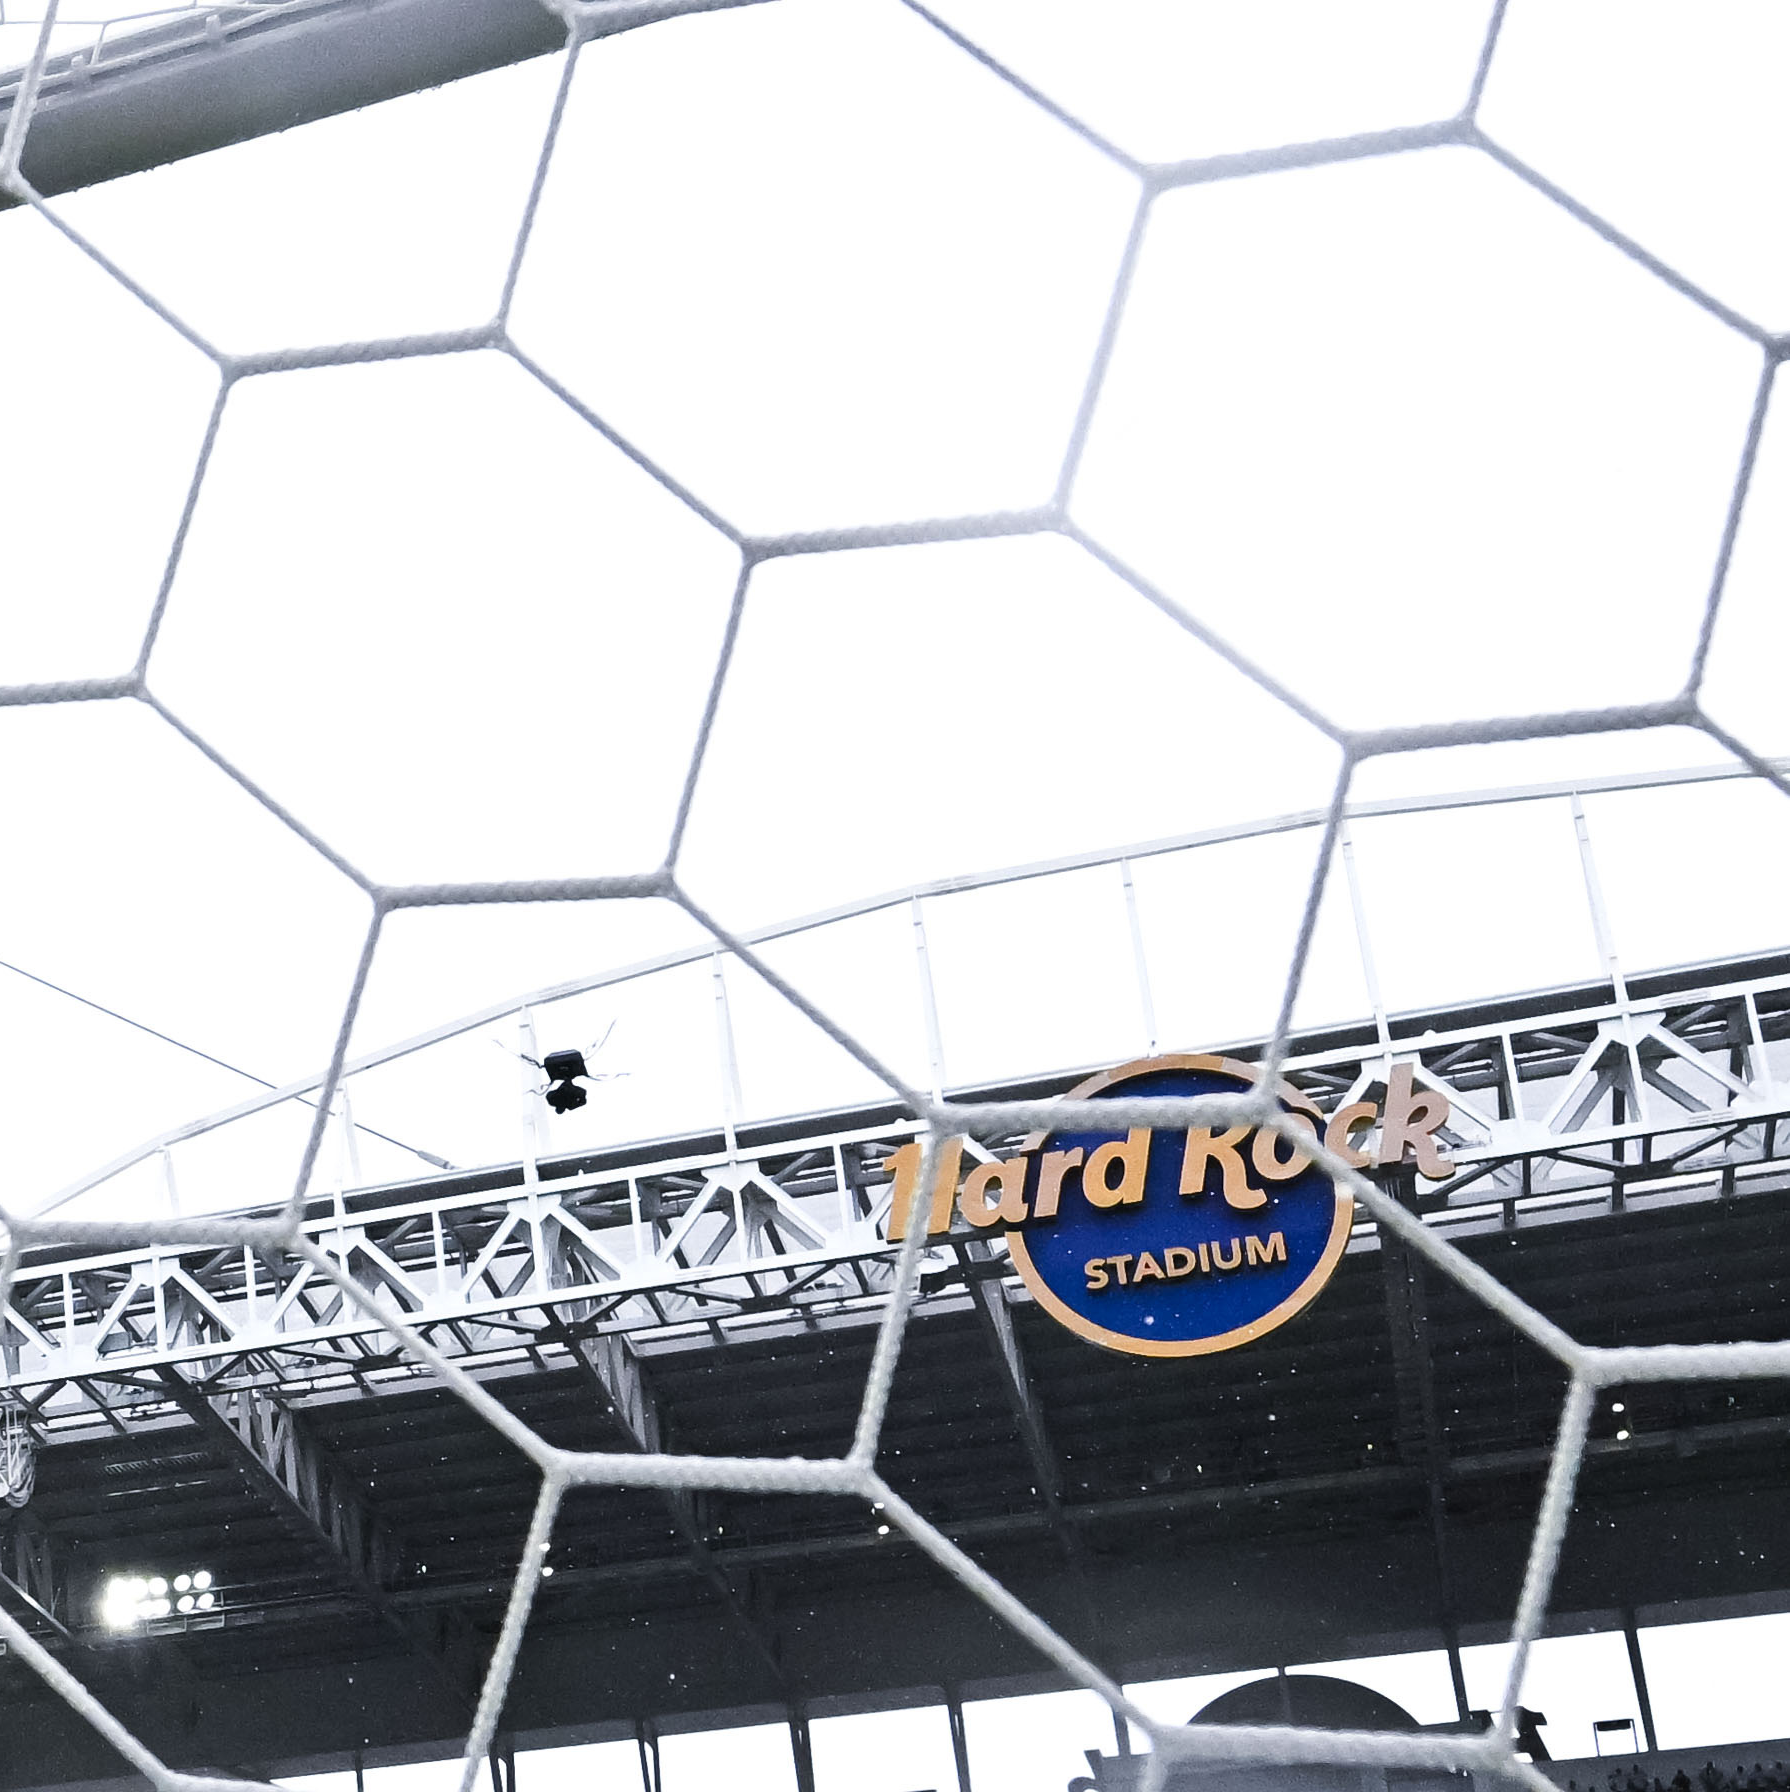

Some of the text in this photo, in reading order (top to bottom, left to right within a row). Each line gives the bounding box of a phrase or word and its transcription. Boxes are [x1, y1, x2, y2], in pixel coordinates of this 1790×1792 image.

[882, 1062, 1457, 1243] Hard Rock
[1084, 1231, 1288, 1290] STADIUM
